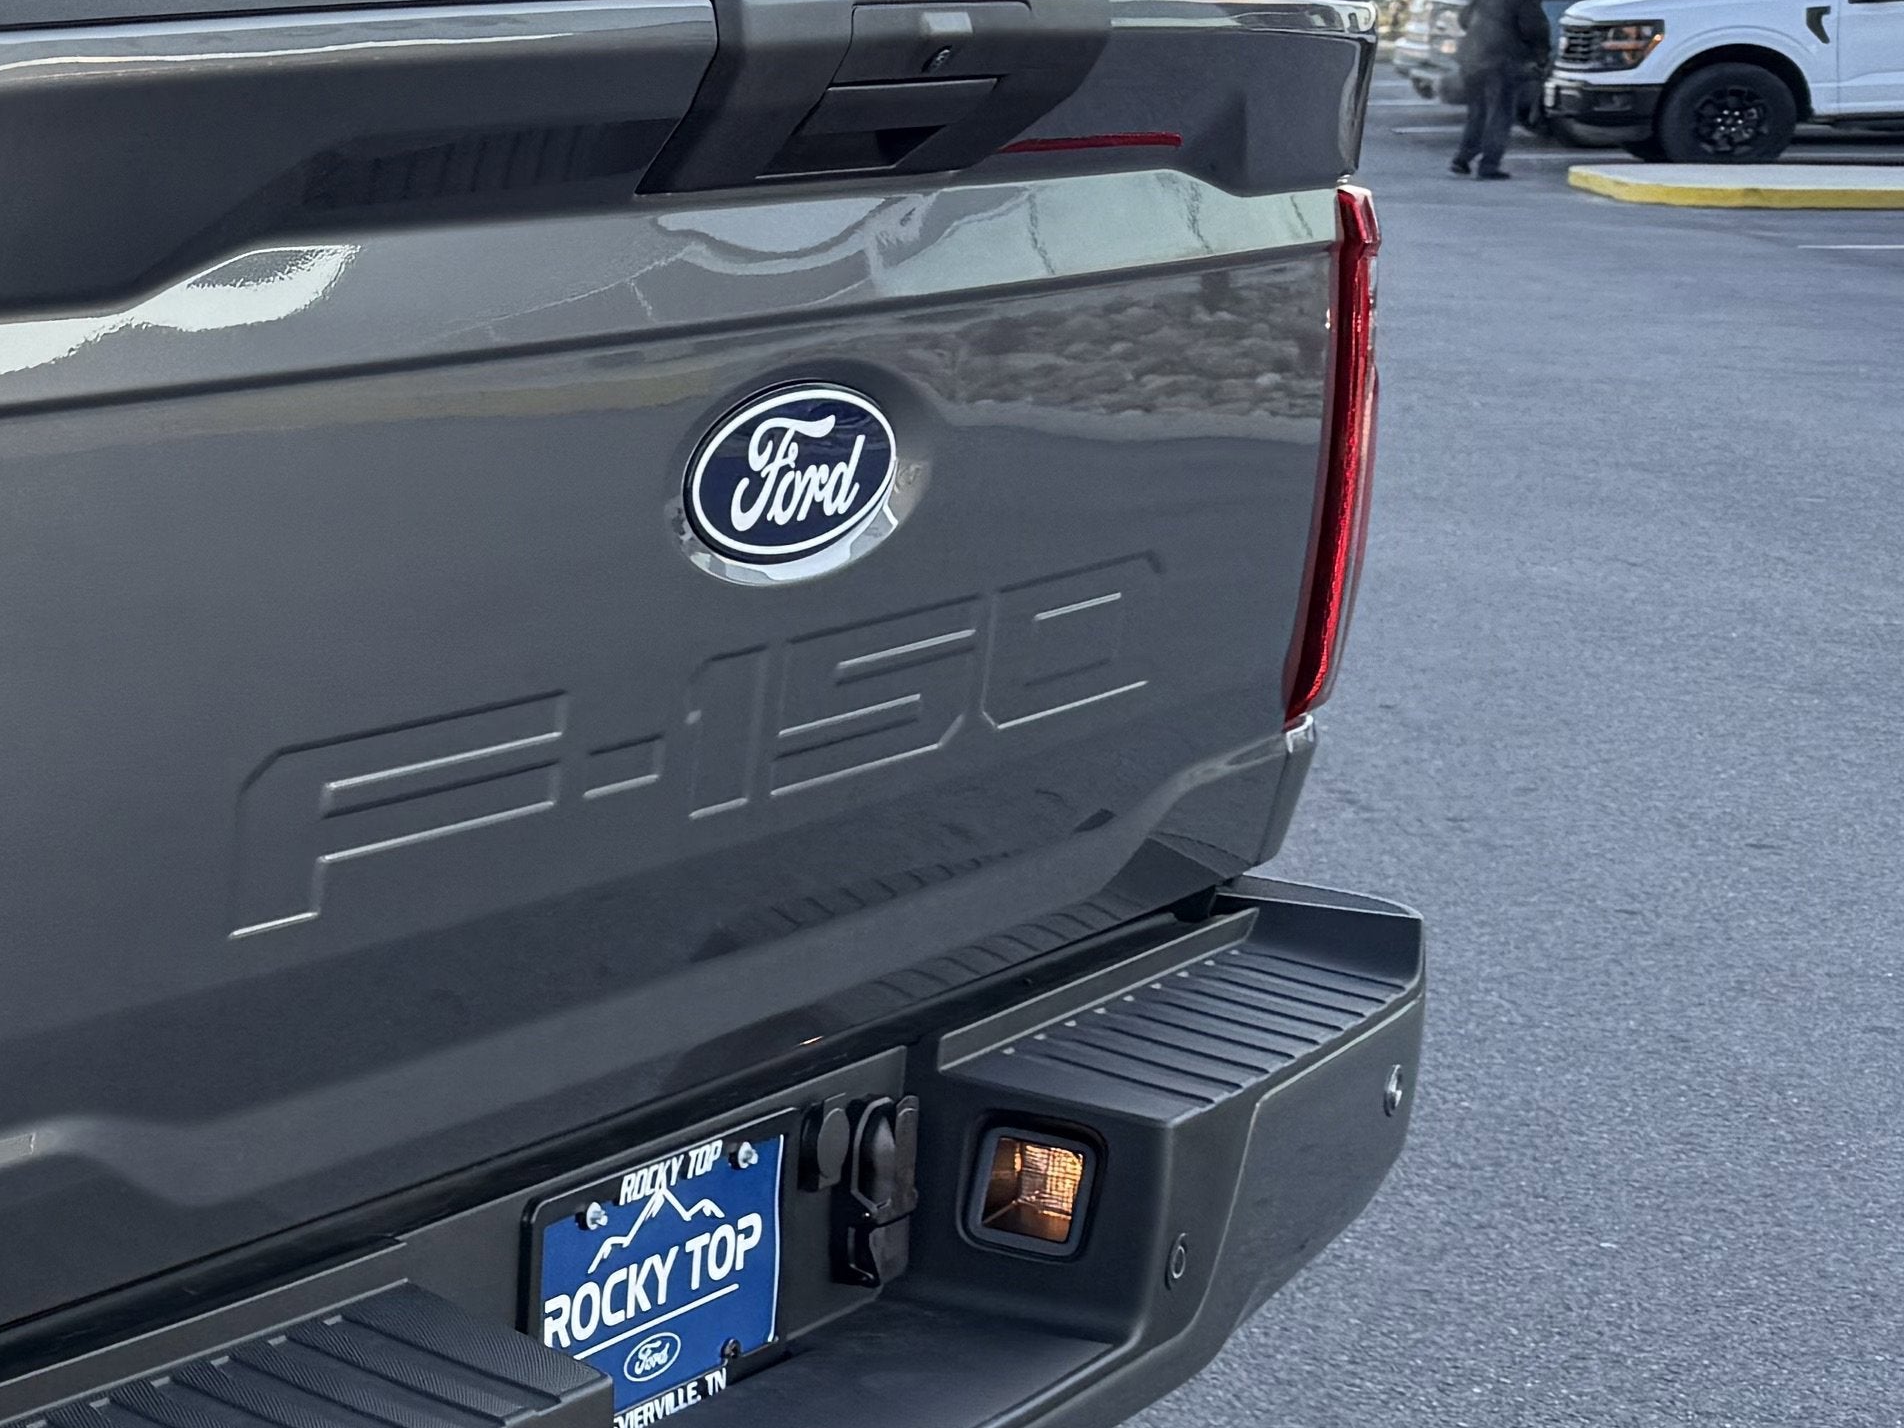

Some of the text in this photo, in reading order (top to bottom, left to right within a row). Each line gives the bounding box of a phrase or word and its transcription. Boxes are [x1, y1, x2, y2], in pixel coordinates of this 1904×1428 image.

[730, 414, 866, 532] Ford
[228, 552, 1163, 940] F-150
[619, 1139, 724, 1206] ROCKY TOP
[543, 1211, 763, 1349] ROCKY TOP
[634, 1340, 671, 1375] Ford
[706, 1367, 727, 1395] TN
